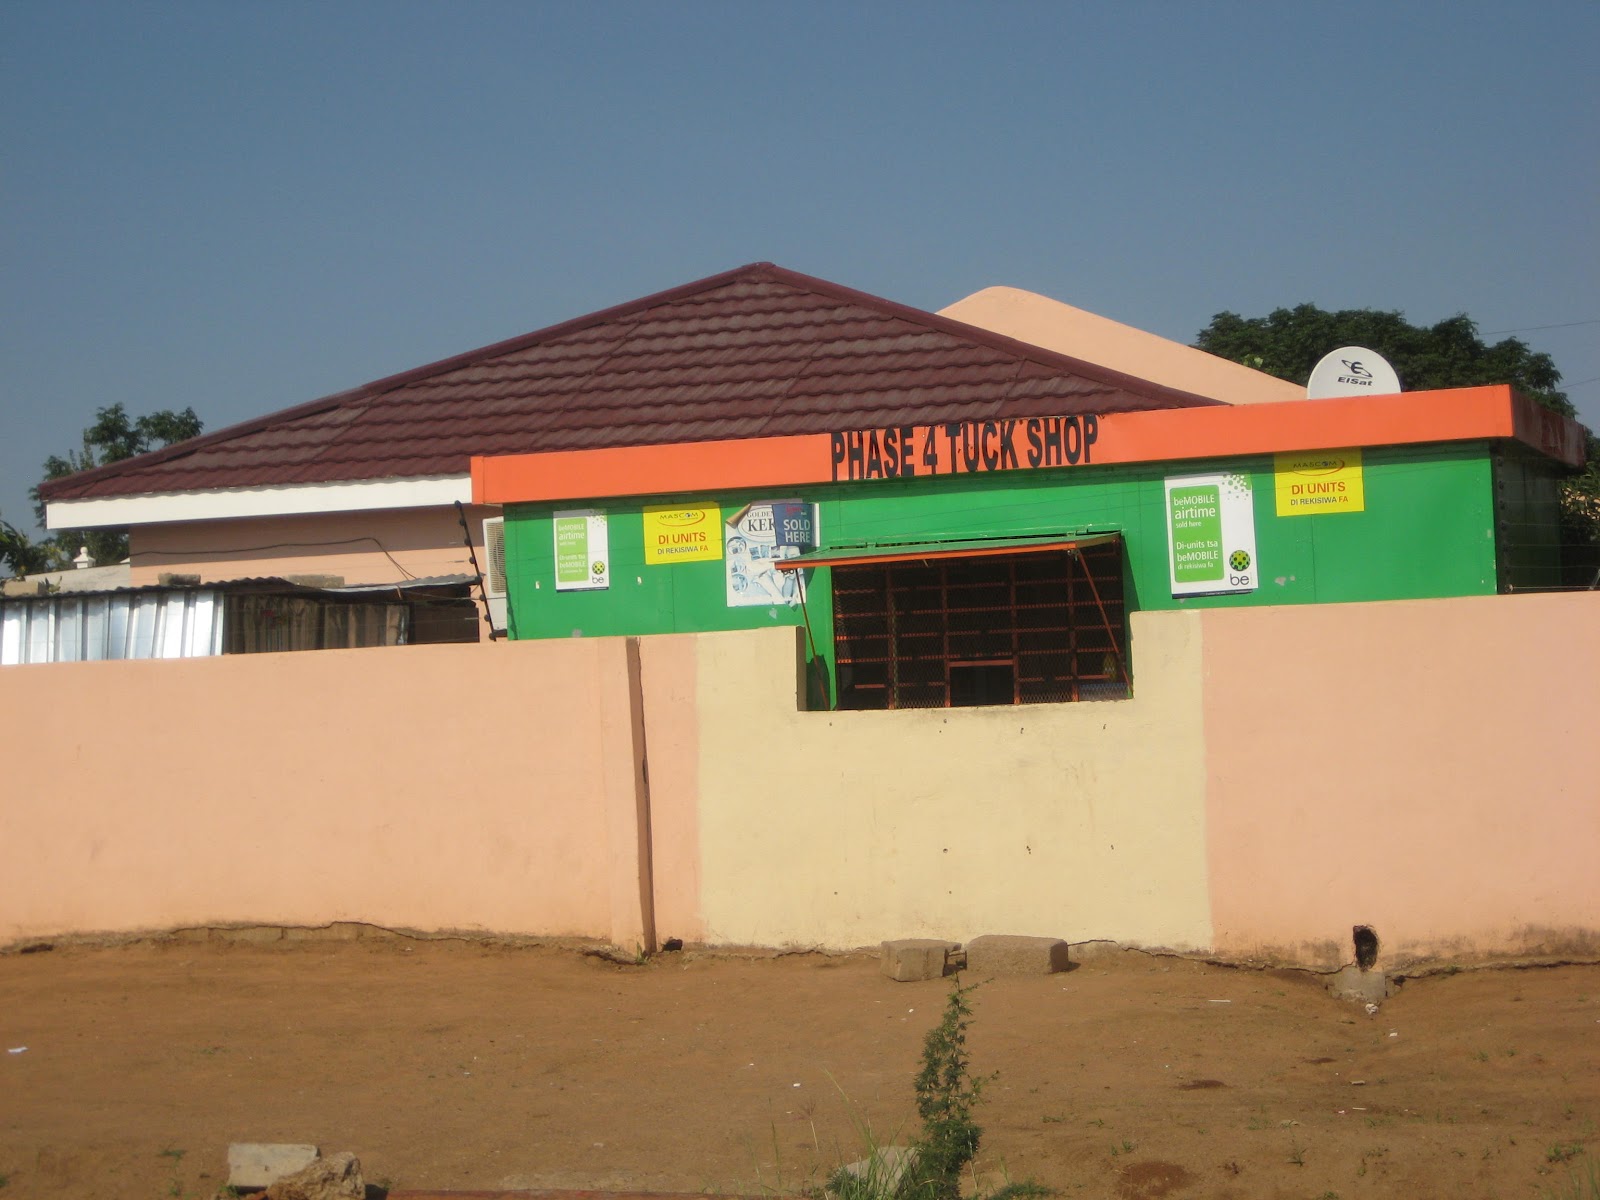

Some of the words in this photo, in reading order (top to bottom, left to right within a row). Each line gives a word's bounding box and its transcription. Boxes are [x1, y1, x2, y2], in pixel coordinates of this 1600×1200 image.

[831, 427, 914, 481] PHASE
[923, 425, 937, 475] 4
[946, 420, 1018, 472] TUCK
[1027, 415, 1098, 468] SHOP
[1293, 460, 1338, 469] MASCOM
[1291, 484, 1304, 495] DI
[1308, 481, 1346, 494] UNITS
[1174, 494, 1215, 506] beMOBILE
[1300, 497, 1337, 505] REKISIWA
[660, 511, 699, 520] MASCOM
[1175, 506, 1216, 520] airtime
[783, 519, 810, 531] SOLD
[559, 531, 585, 540] airtime
[658, 534, 670, 545] DI
[672, 532, 706, 544] UNITS
[785, 531, 810, 543] HERE
[666, 546, 699, 554] REKISIWA
[1176, 541, 1205, 550] Di-units
[1177, 550, 1218, 562] beMOBILE
[1178, 562, 1183, 570] di
[592, 576, 604, 584] be
[1230, 574, 1249, 586] be
